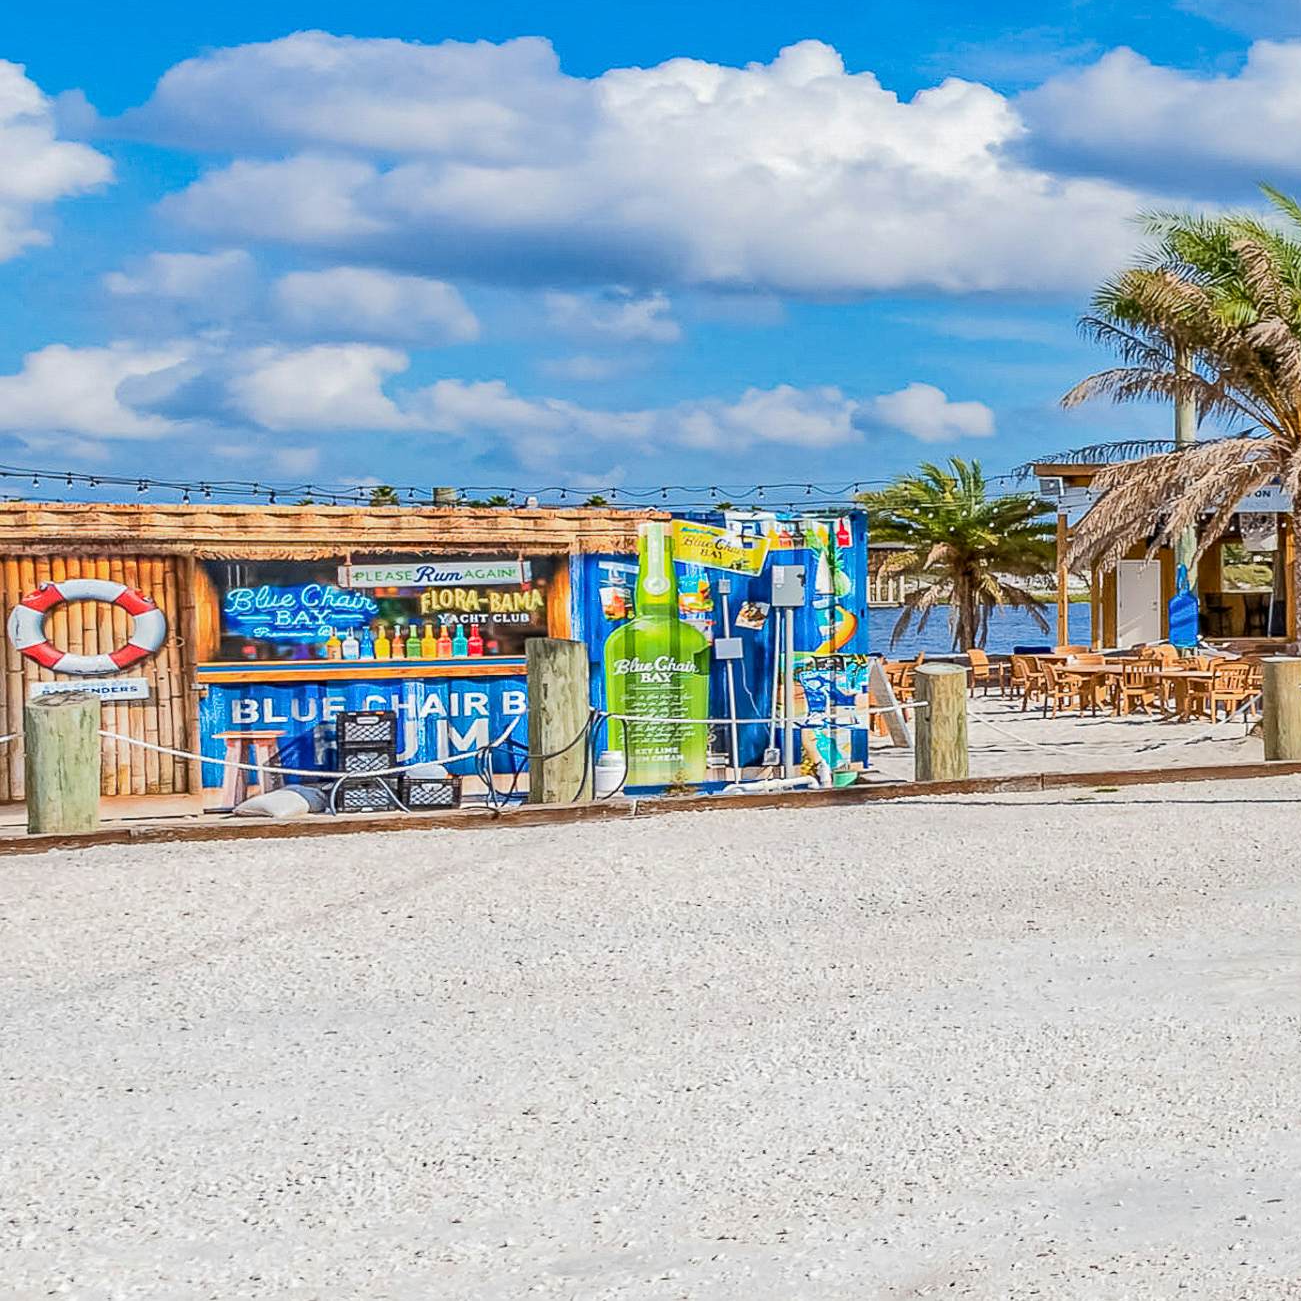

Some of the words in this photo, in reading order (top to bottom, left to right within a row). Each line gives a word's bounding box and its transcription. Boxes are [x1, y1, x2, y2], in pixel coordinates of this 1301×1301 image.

[414, 565, 463, 582] Rum
[224, 585, 297, 612] Blue
[300, 584, 379, 612] Chair
[420, 588, 545, 614] FLORA-BAMA
[273, 609, 332, 626] BAY
[437, 613, 490, 624] YACHT
[493, 613, 531, 623] CLUB
[612, 657, 654, 675] Blue
[653, 656, 699, 673] Chair
[640, 672, 674, 683] BAY
[231, 696, 345, 724] BLUE
[364, 692, 490, 720] CHAIR
